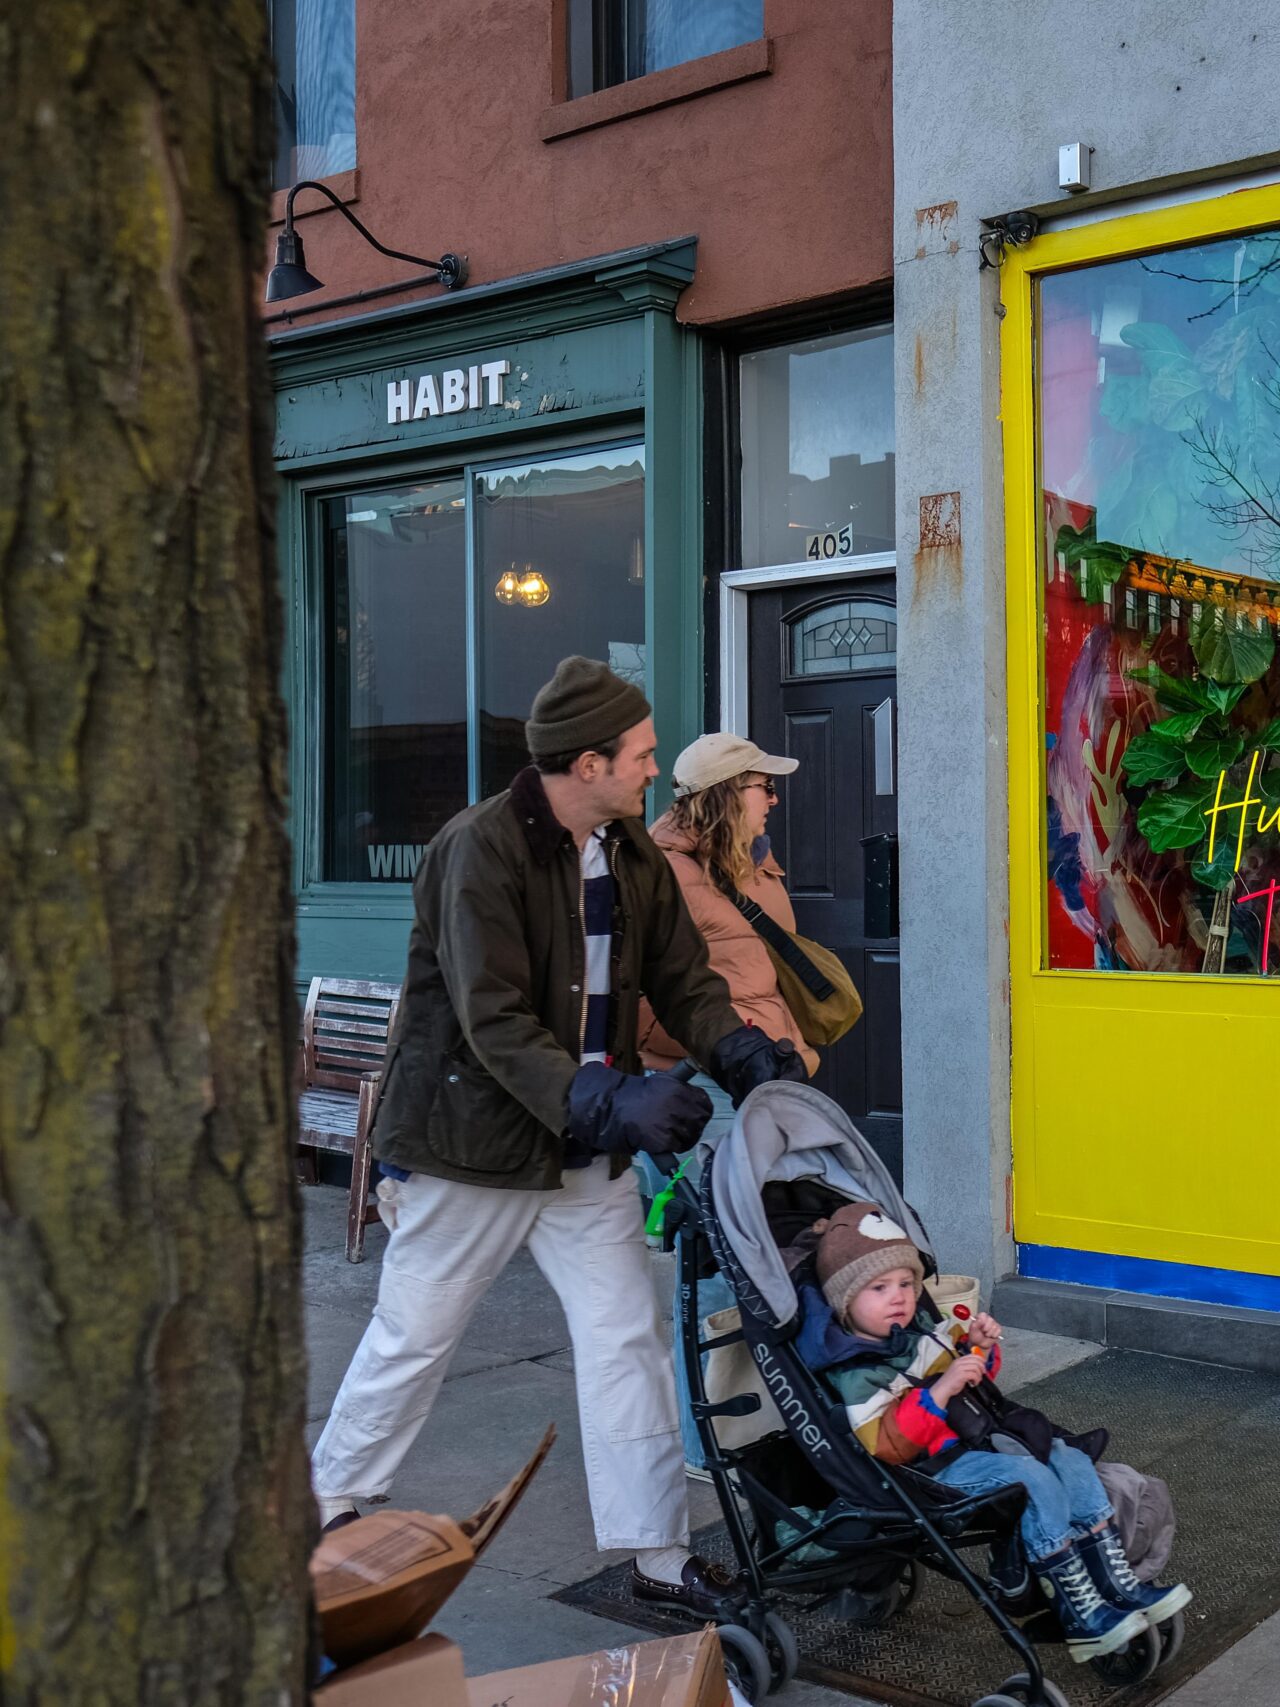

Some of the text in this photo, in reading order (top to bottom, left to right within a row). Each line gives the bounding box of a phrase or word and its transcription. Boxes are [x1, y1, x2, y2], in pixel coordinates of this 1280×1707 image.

[387, 360, 510, 425] HABIT
[808, 526, 852, 561] 405
[367, 844, 432, 878] WIN
[753, 1343, 832, 1453] summer
